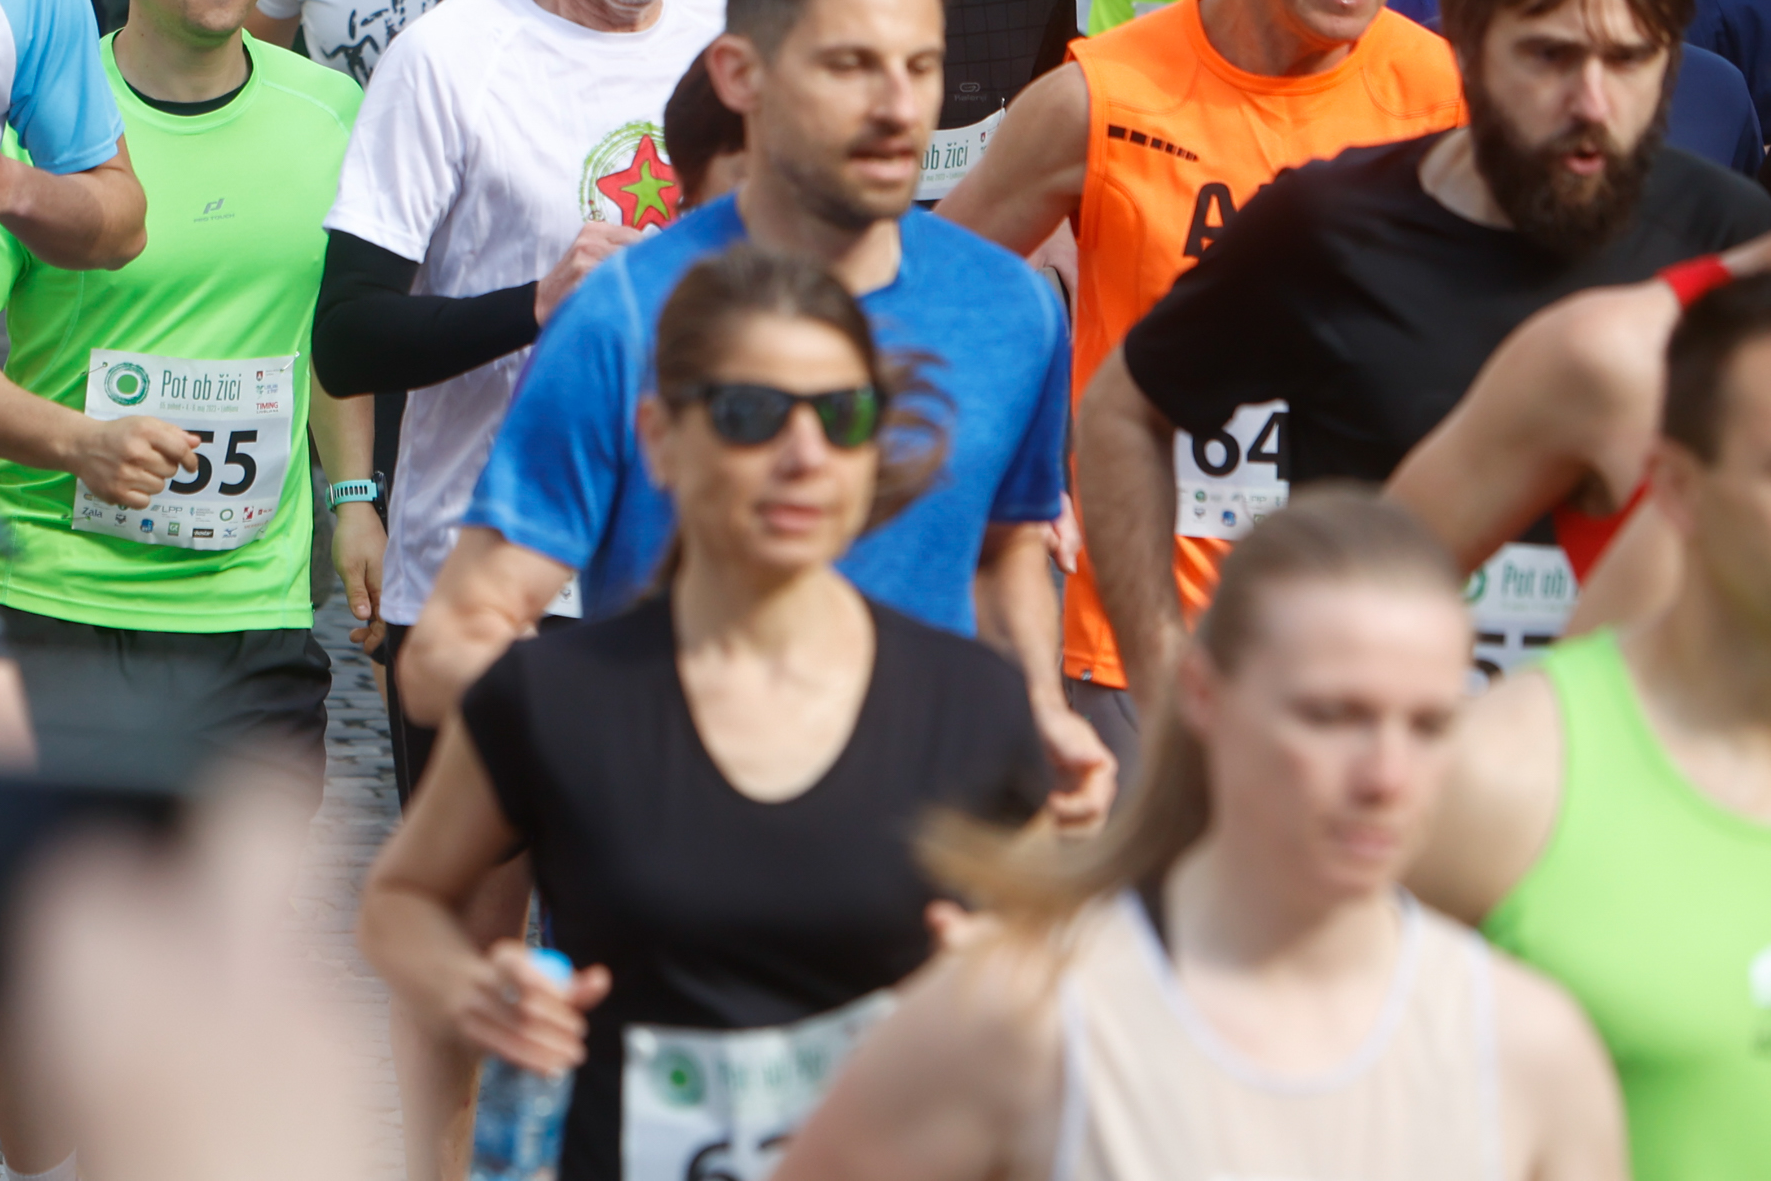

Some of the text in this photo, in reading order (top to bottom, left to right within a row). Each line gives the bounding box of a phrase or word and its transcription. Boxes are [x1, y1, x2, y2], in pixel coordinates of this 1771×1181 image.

[920, 139, 970, 171] ob žici
[161, 370, 242, 402] Pot ob žici
[256, 401, 279, 410] TIMING
[82, 507, 103, 518] Zala
[161, 505, 183, 514] LPP
[1501, 559, 1536, 599] Pot
